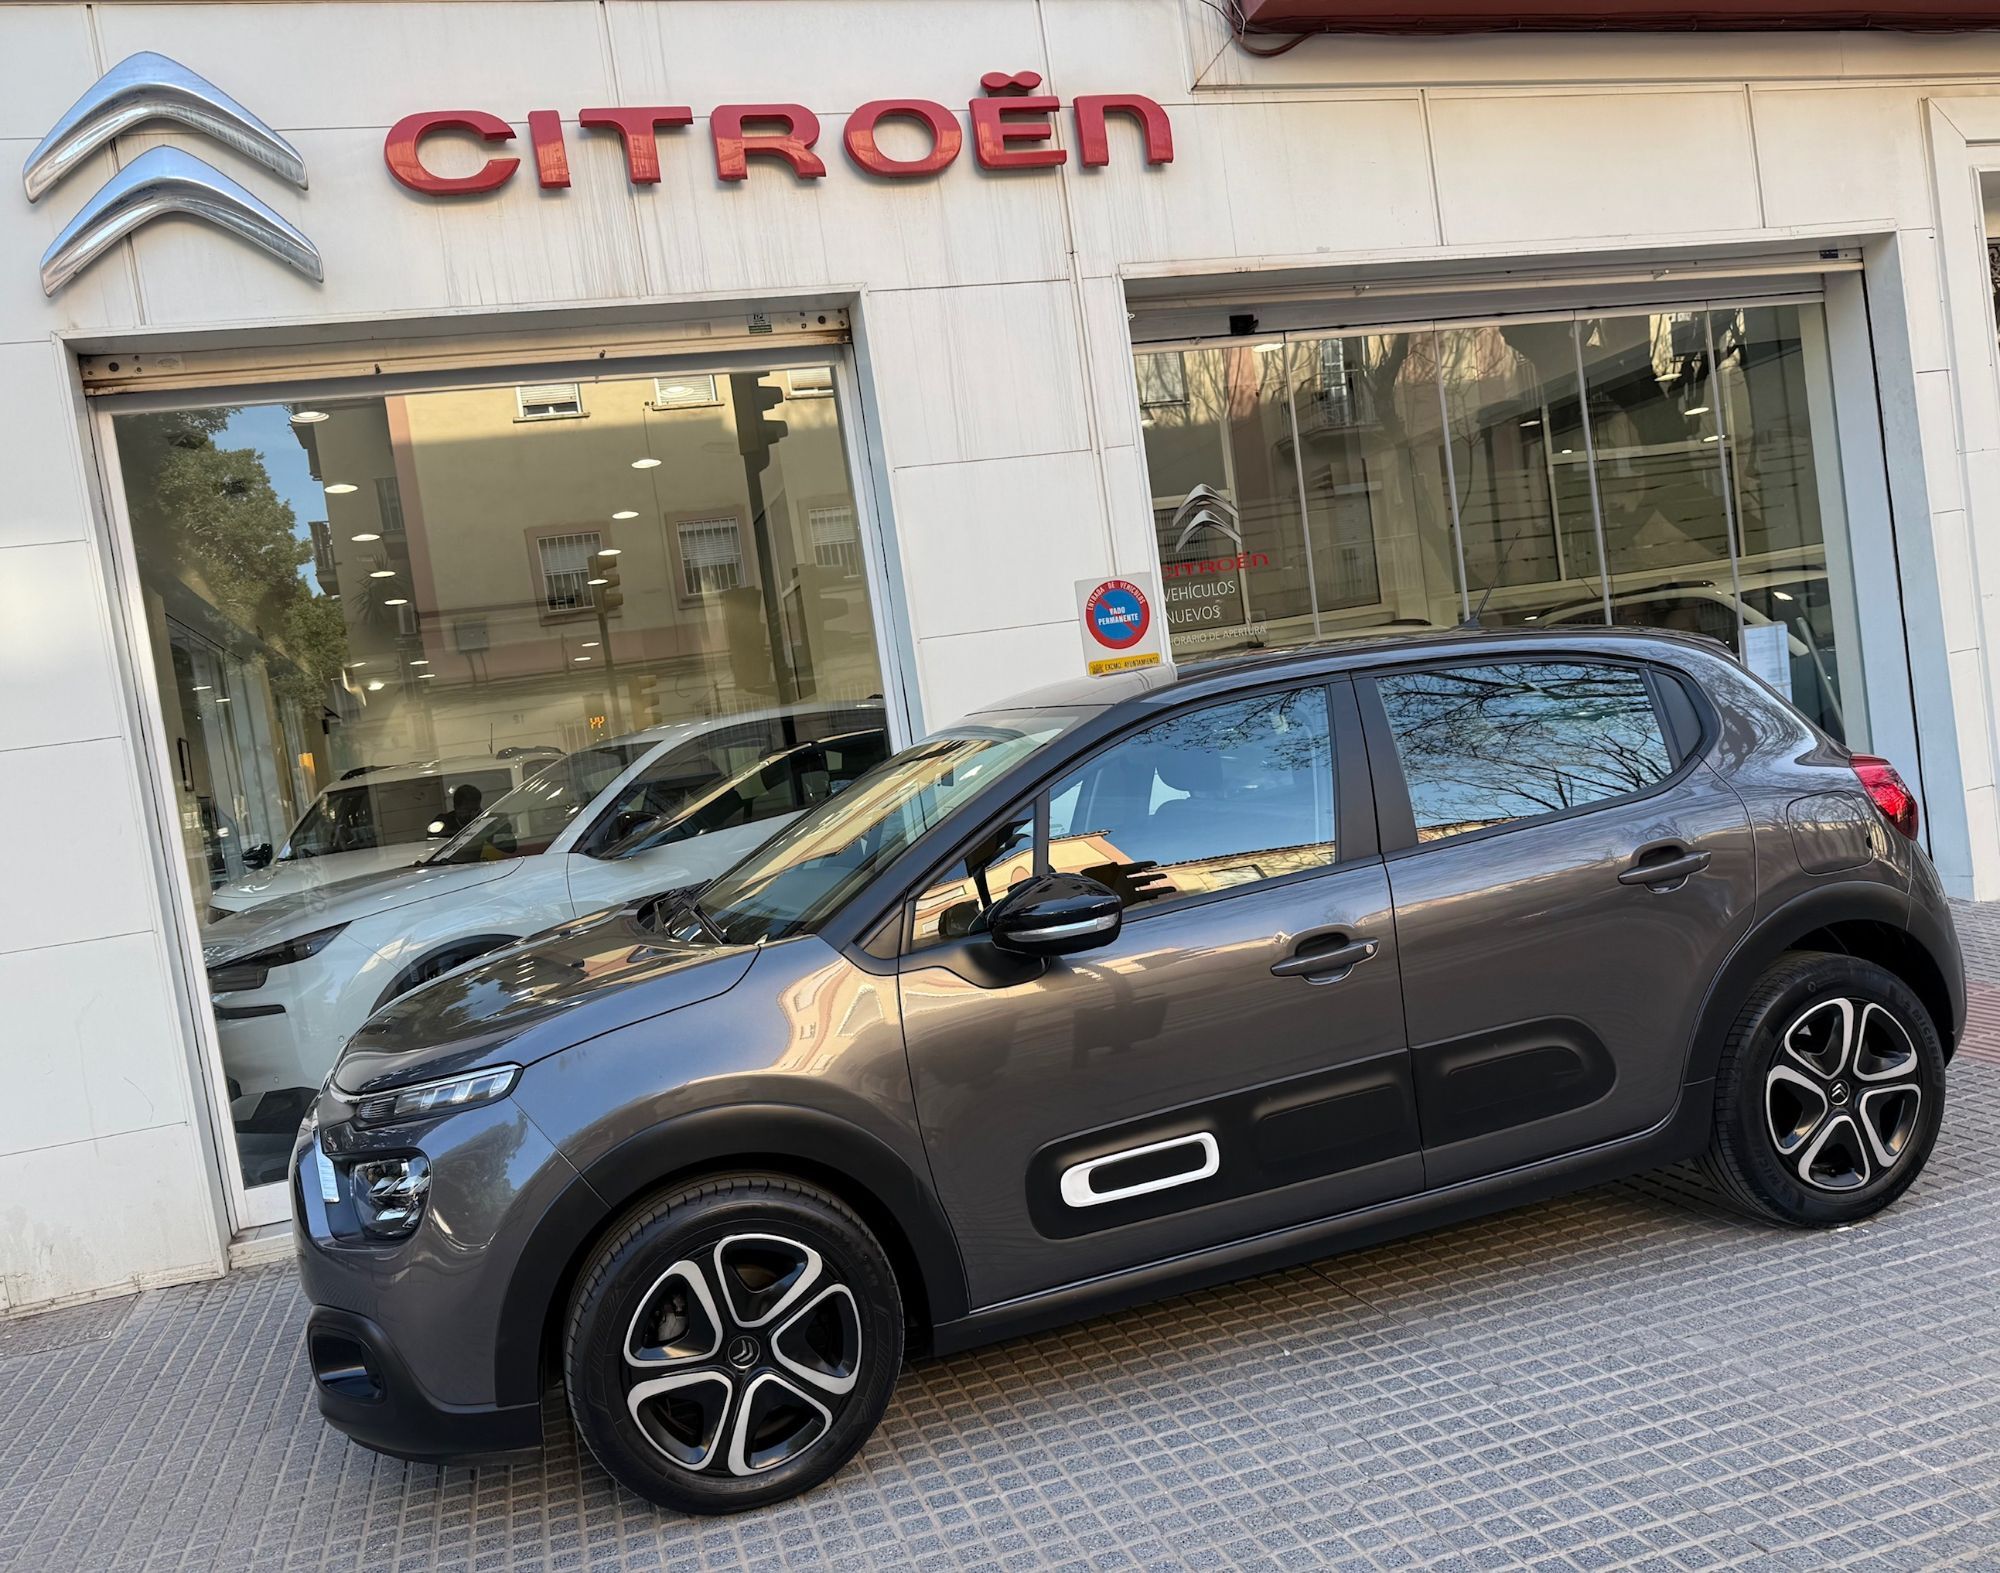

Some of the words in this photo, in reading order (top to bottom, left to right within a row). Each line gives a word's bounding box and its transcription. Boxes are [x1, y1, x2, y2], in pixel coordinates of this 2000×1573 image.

[1086, 587, 1106, 611] ENTRADA
[1107, 581, 1115, 589] DE
[1164, 580, 1236, 602] VEHÍCULOS
[1098, 612, 1139, 626] PERMANENTE
[1109, 606, 1126, 616] VADO
[1166, 605, 1221, 624] NUEVOS
[1209, 631, 1221, 641] DE
[1223, 625, 1267, 639] APERTURA
